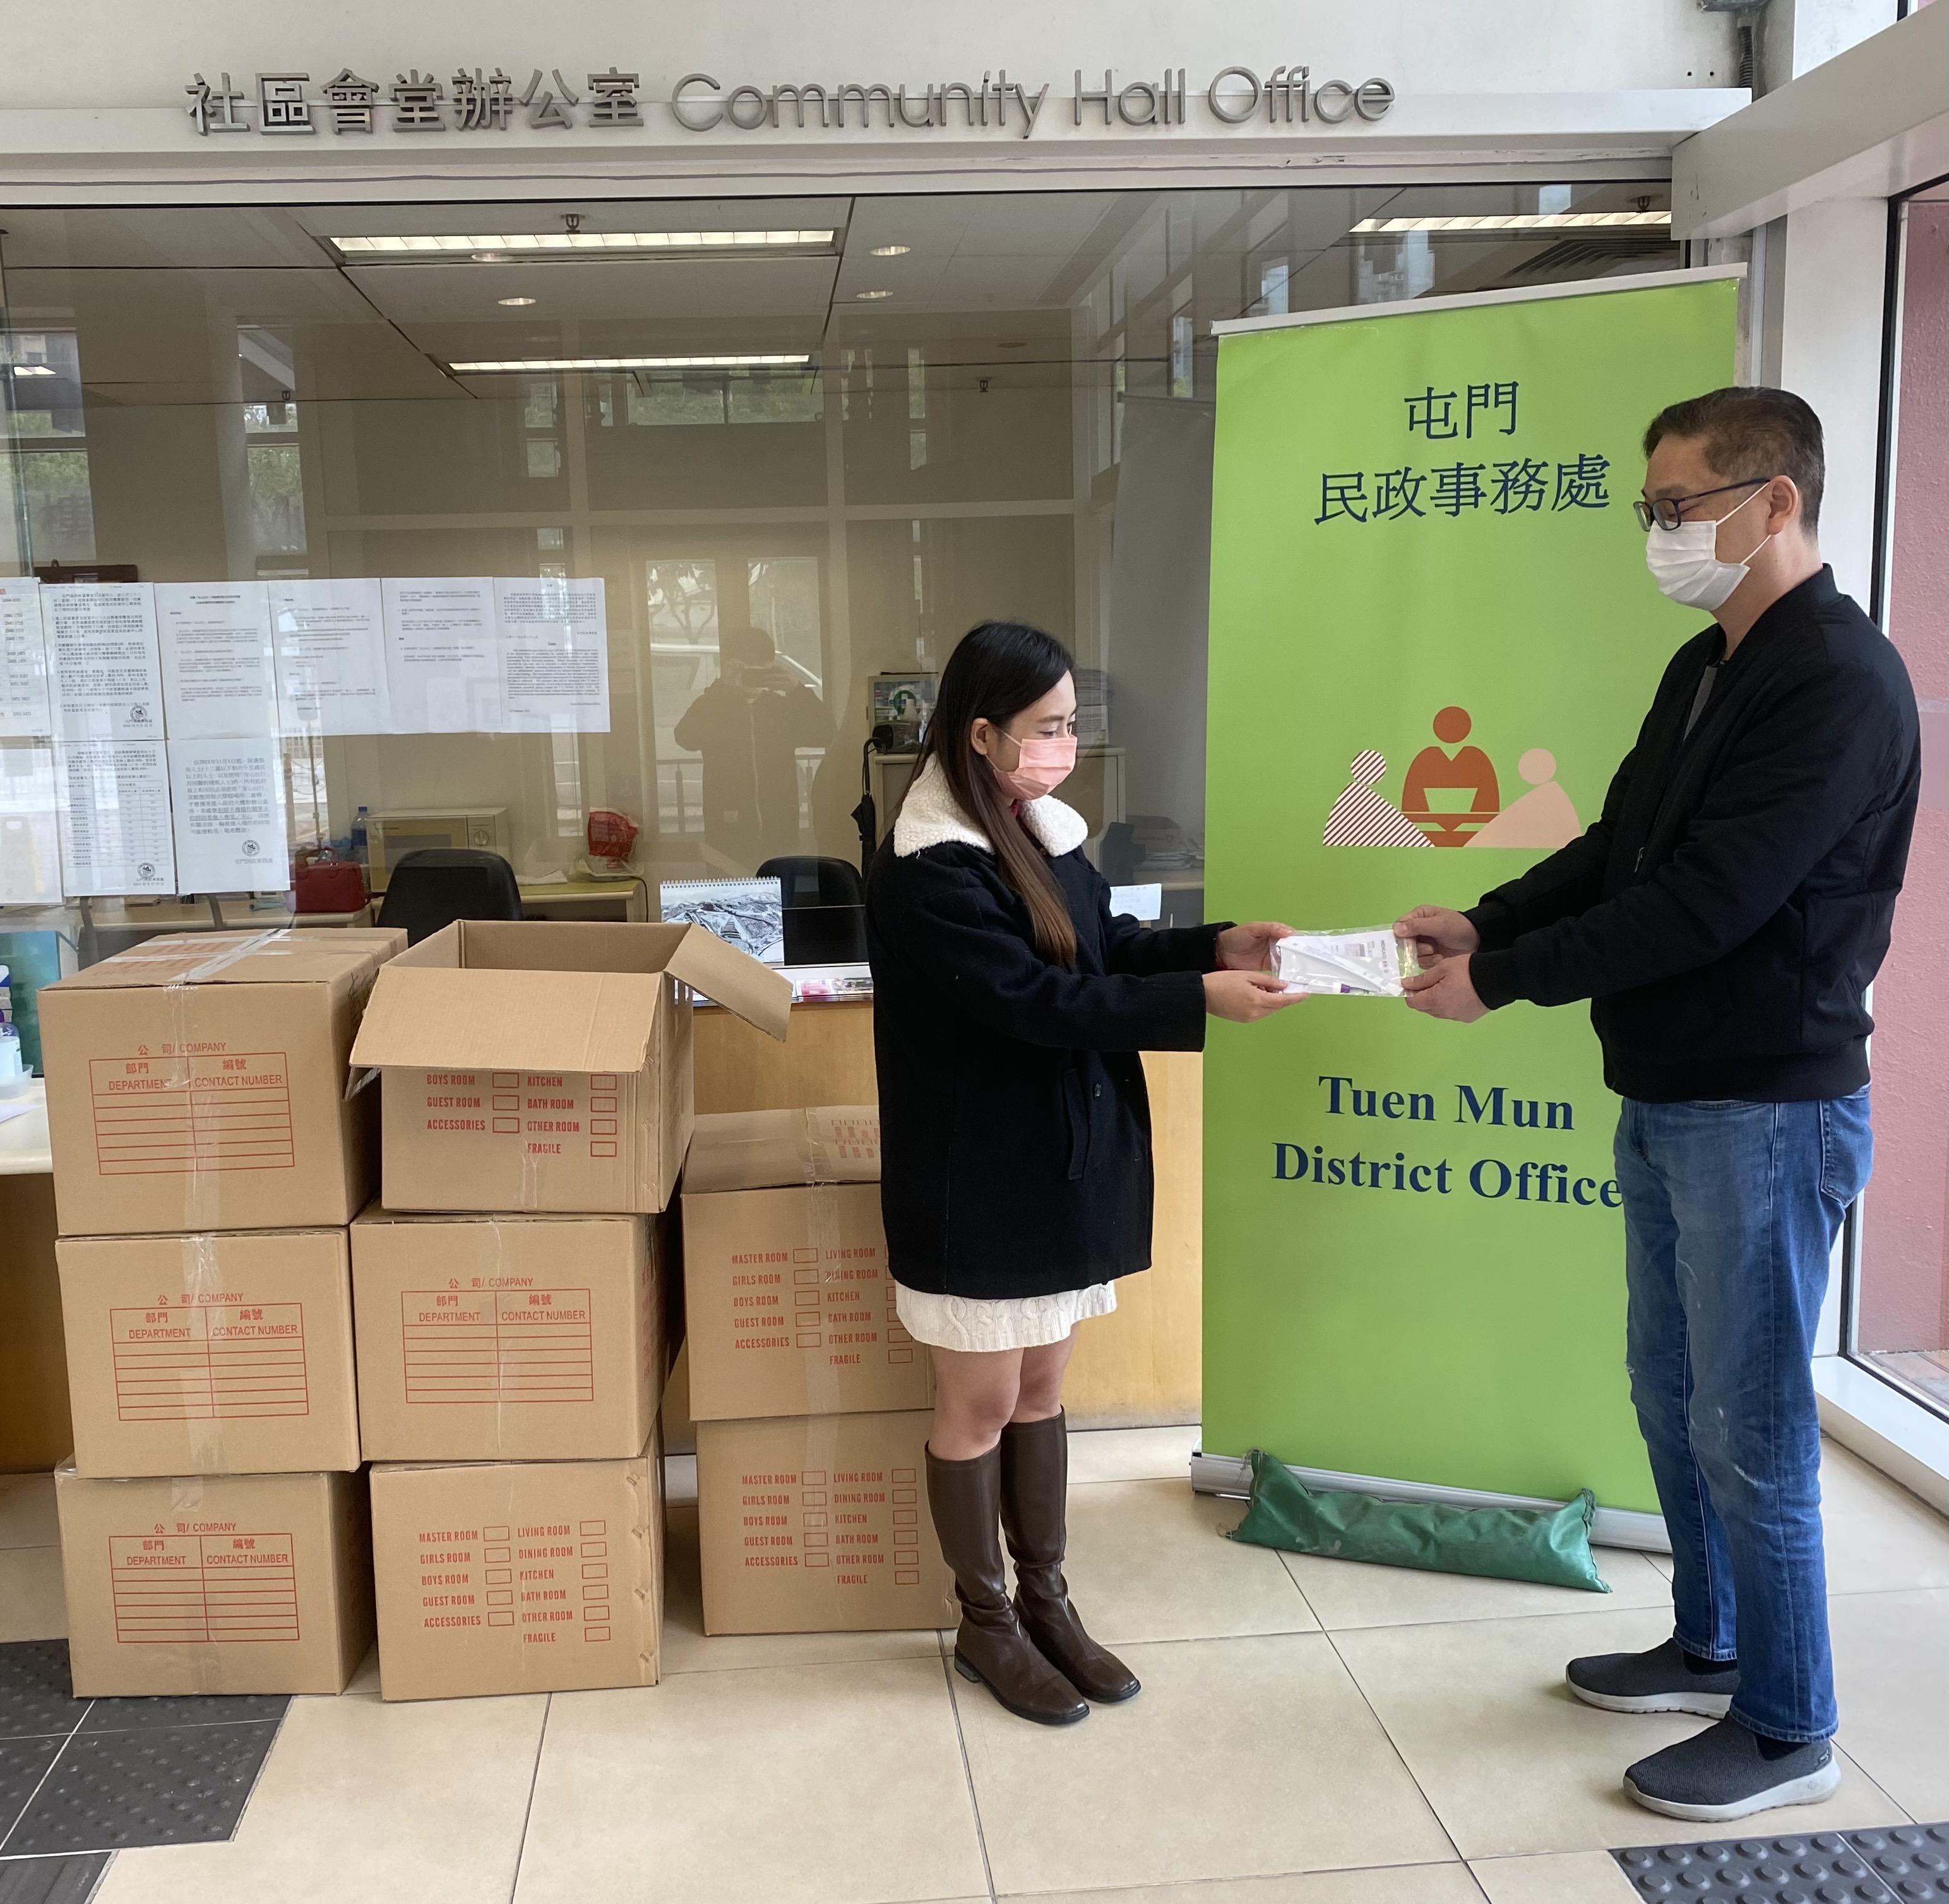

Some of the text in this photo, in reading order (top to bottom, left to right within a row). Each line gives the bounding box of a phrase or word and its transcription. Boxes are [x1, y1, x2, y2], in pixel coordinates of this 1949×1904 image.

[185, 65, 1395, 140] 社區會堂辦公室 Community Hall Office
[1404, 381, 1518, 439] 屯門
[1314, 453, 1610, 525] 民政事務處
[179, 1042, 227, 1053] COMPANY
[126, 1062, 150, 1074] 部門
[222, 1058, 247, 1071] 編號
[194, 1074, 282, 1087] CONTACT NUMBER
[426, 1075, 475, 1086] BOYS ROOM
[527, 1076, 563, 1087] KITCHEN
[427, 1097, 480, 1108] GUEST ROOM
[527, 1098, 574, 1110] BATH ROOM
[1318, 1076, 1575, 1130] Tuen Mun
[427, 1119, 486, 1131] ACCESSORIES
[527, 1121, 580, 1133] OTHER ROOM
[527, 1143, 561, 1154] FRAGILE
[1272, 1141, 1623, 1208] District Office
[732, 1252, 788, 1264] MASTER ROOM
[825, 1247, 876, 1259] LIVING ROOM
[732, 1273, 780, 1286] GIRLS ROOM
[855, 1269, 878, 1280] ROOM
[488, 1276, 533, 1288] COMPANY
[198, 1292, 244, 1303] COMPANY
[436, 1295, 459, 1307] 部門
[528, 1294, 552, 1306] 編號
[734, 1295, 778, 1307] BOYS ROOM
[827, 1291, 860, 1302] KITCHEN
[145, 1311, 168, 1324] 部門
[239, 1309, 263, 1321] 編號
[419, 1311, 480, 1323] DEPARTMENT
[501, 1309, 585, 1321] CONTACT NUMBER
[828, 1312, 871, 1323] BATH ROOM
[734, 1316, 784, 1328] GUEST ROOM
[128, 1328, 191, 1340] DEPARTMENT
[212, 1324, 297, 1337] CONTACT NUMBER
[735, 1337, 790, 1349] ACCESSORIES
[828, 1332, 877, 1344] OTHER ROOM
[830, 1355, 861, 1365] FRAGILE
[742, 1474, 797, 1485] MASTER ROOM
[833, 1472, 883, 1483] LIVING ROOM
[742, 1494, 789, 1506] GIRLS ROOM
[834, 1492, 885, 1503] DINING ROOM
[744, 1515, 787, 1526] BOYS ROOM
[835, 1514, 867, 1523] KITCHEN
[193, 1522, 236, 1532] COMPANY
[517, 1525, 571, 1537] LIVING ROOM
[419, 1529, 479, 1543] MASTER ROOM
[744, 1535, 793, 1546] GUEST ROOM
[835, 1533, 878, 1544] BATH ROOM
[142, 1540, 164, 1551] 部門
[232, 1538, 255, 1550] 編號
[206, 1553, 289, 1564] CONTACT NUMBER
[420, 1552, 471, 1564] GIRLS ROOM
[518, 1546, 573, 1559] DINING ROOM
[837, 1553, 884, 1564] OTHER ROOM
[126, 1555, 186, 1566] DEPARTMENT
[744, 1556, 798, 1566] ACCESSORIES
[421, 1573, 468, 1586] BOYS ROOM
[519, 1569, 554, 1581] KITCHEN
[837, 1574, 867, 1584] FRAGILE
[422, 1594, 475, 1607] GUEST ROOM
[521, 1589, 566, 1602] BATH ROOM
[424, 1615, 481, 1627] ACCESSORIES
[522, 1610, 573, 1622] OTHER ROOM
[523, 1632, 556, 1643] FRAGILE
